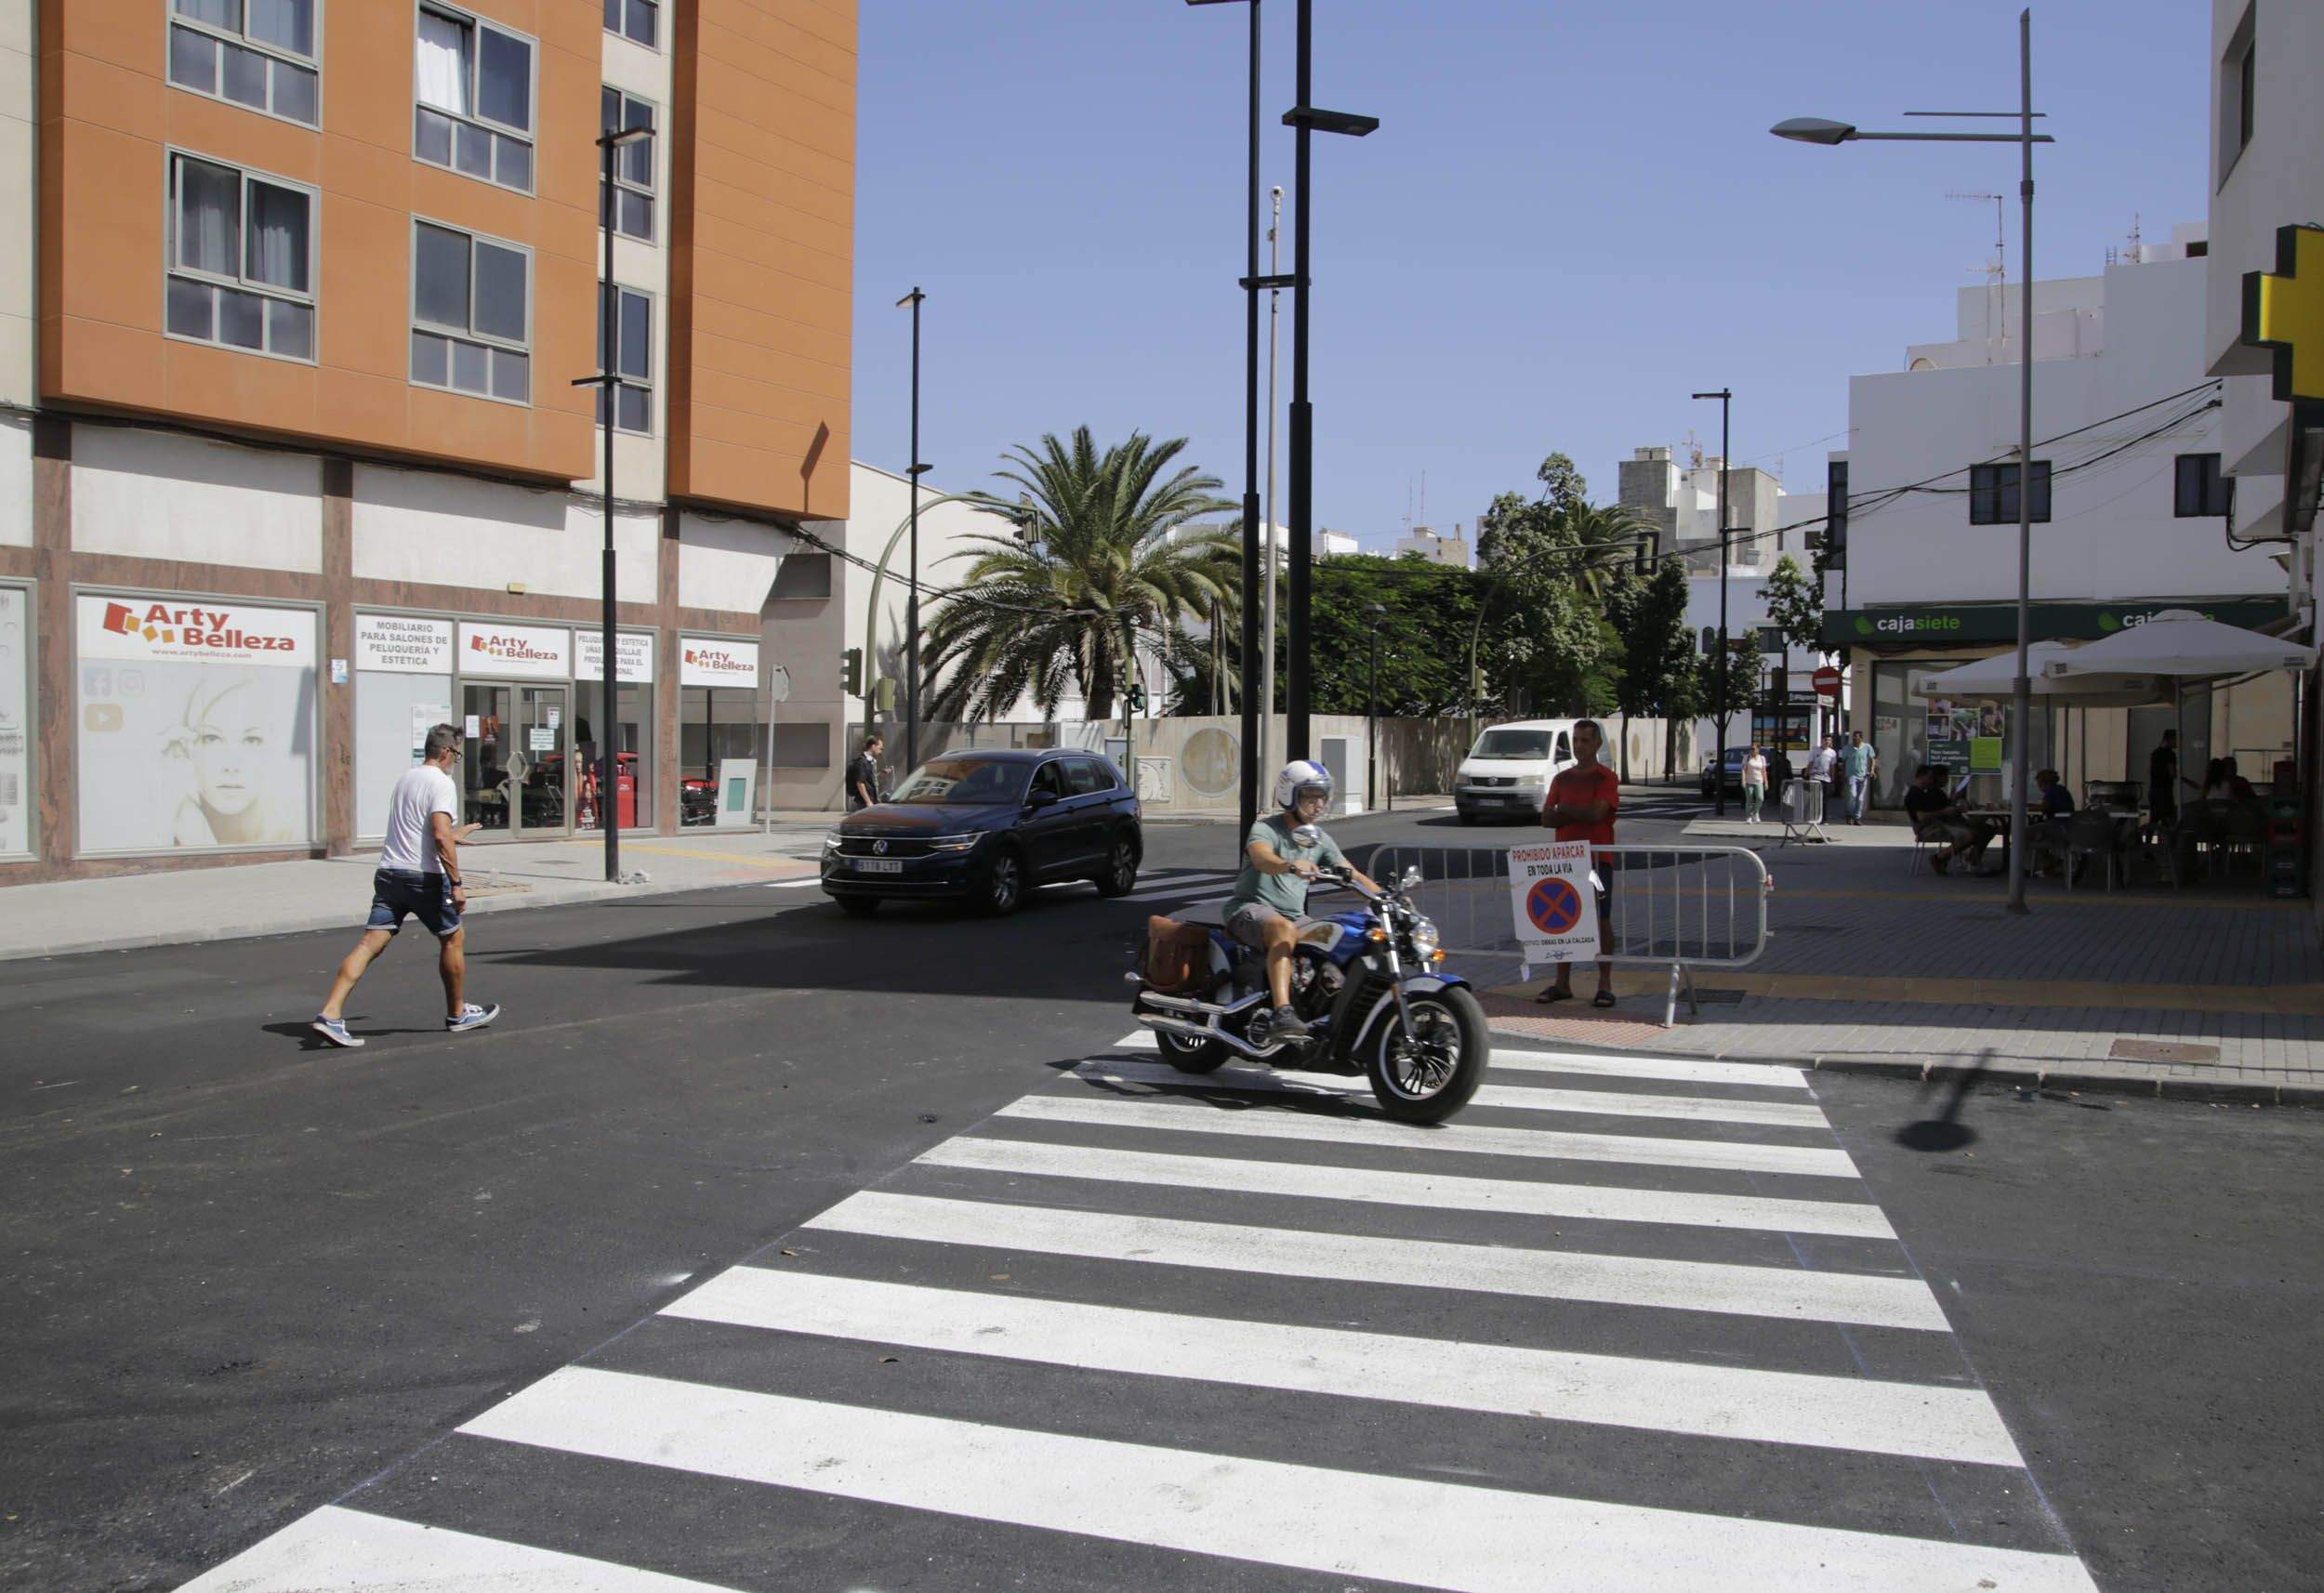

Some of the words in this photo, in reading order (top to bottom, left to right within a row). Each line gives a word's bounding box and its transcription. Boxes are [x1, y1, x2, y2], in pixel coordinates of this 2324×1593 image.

[144, 604, 230, 633] Arty
[1877, 615, 1961, 633] cajasiete
[376, 621, 433, 632] MOBILIARIO
[183, 627, 295, 652] Belleza
[361, 631, 387, 640] PARA
[389, 633, 433, 644] SALONES
[436, 636, 447, 645] DE
[489, 635, 528, 650] Arty
[369, 643, 430, 654] PELUQUERIA
[432, 647, 440, 655] Y
[506, 646, 559, 661] Belleza
[699, 649, 730, 663] Arty
[381, 655, 429, 665] ESTETICA
[713, 660, 754, 672] Belleza
[1512, 847, 1552, 862] PROHIBIDO
[1552, 844, 1585, 860] APARCAR
[1527, 865, 1537, 876] EN
[1537, 863, 1553, 875] TODA
[1554, 862, 1563, 875] LA
[1572, 936, 1595, 944] CALZADA
